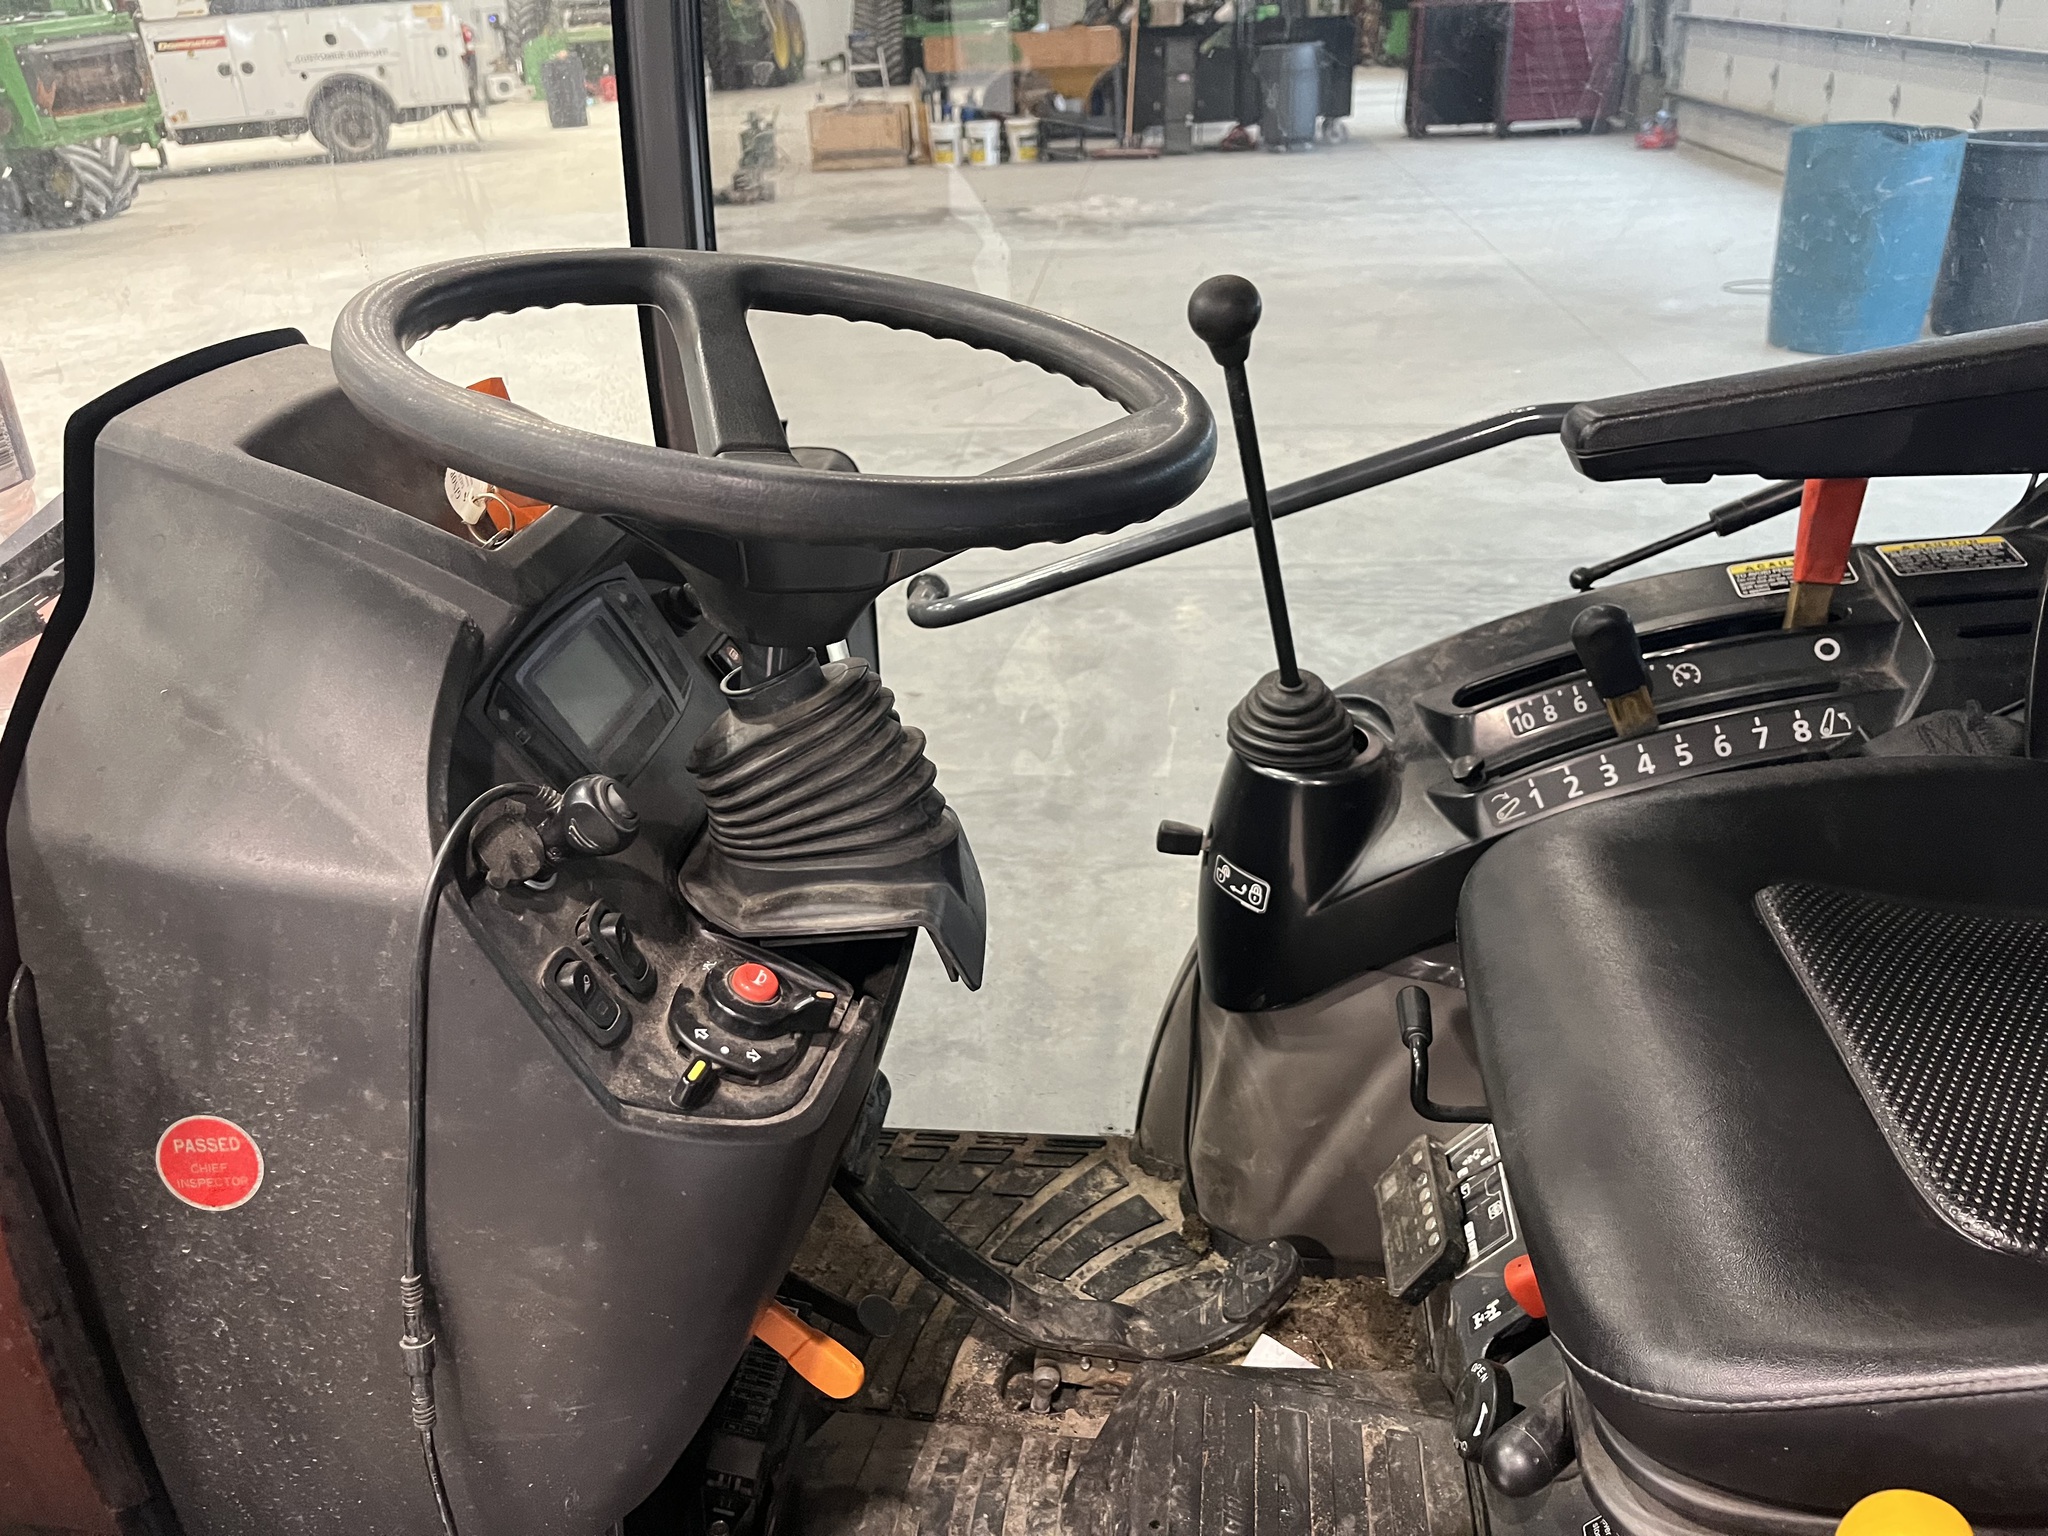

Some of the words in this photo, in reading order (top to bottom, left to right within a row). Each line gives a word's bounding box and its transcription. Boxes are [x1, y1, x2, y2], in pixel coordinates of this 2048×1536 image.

[1512, 713, 1535, 733] 10
[1543, 705, 1558, 722] 8
[1574, 695, 1588, 713] 6
[1529, 788, 1545, 809] 1
[1563, 776, 1584, 799] 2
[1599, 763, 1619, 787] 3
[1637, 753, 1656, 775] 4
[1674, 743, 1694, 767] 5
[1714, 734, 1733, 757] 6
[1751, 726, 1768, 750] 7
[1792, 720, 1812, 742] 8
[172, 1136, 241, 1154] PASSED
[190, 1163, 229, 1174] CHIEF
[176, 1176, 249, 1189] INSPECTOR
[1470, 1362, 1489, 1384] OPEN
